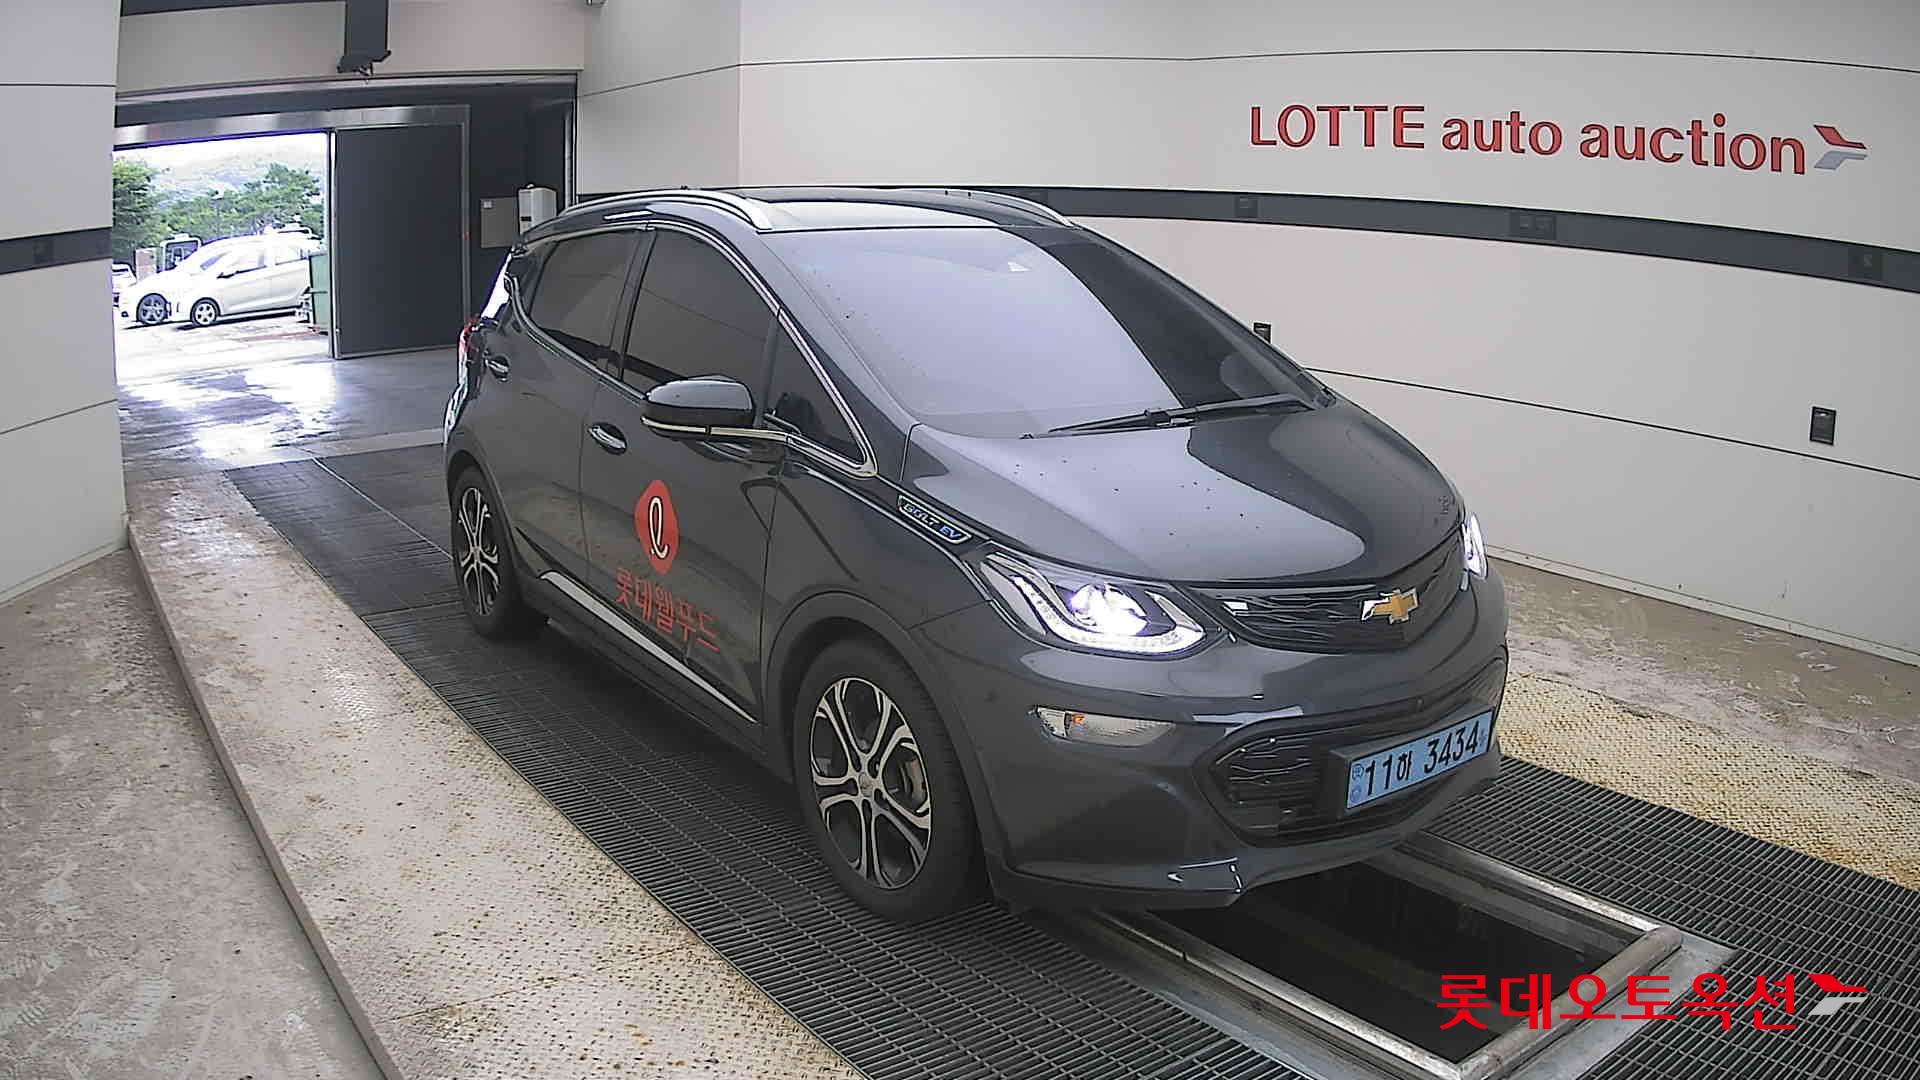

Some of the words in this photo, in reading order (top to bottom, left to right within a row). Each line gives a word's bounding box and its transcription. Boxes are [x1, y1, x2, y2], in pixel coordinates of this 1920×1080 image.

[1250, 104, 1425, 149] LOTTE
[1441, 110, 1563, 156] auto
[1579, 113, 1806, 175] auction
[903, 503, 941, 527] BOLT
[939, 525, 962, 539] EV
[615, 567, 720, 653] 롯데웰푸드
[1365, 750, 1413, 796] 11하
[1423, 720, 1480, 774] 3434
